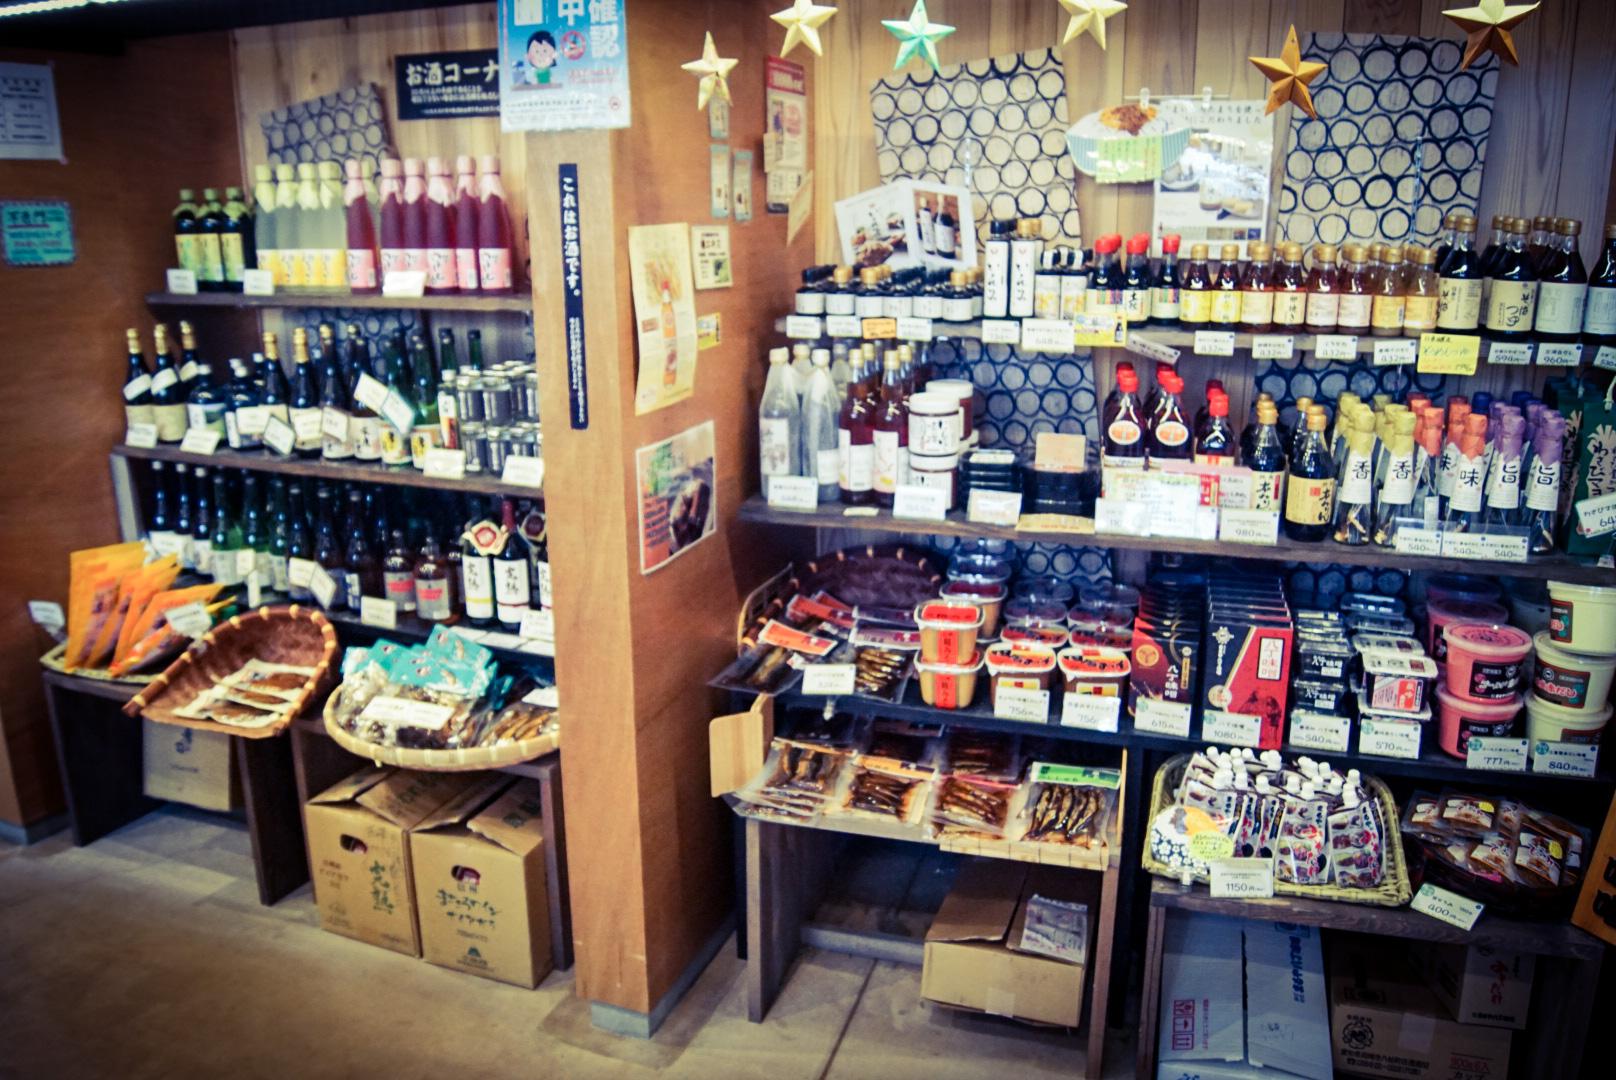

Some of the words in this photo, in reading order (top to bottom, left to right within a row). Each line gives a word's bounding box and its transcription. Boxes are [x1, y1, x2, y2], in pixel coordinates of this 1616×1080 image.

[563, 177, 580, 296] これはお酒です。
[1352, 460, 1370, 480] 香
[1392, 460, 1411, 480] 香
[1460, 468, 1479, 487] 味
[1502, 464, 1518, 483] 旨
[1537, 465, 1555, 485] 旨
[1165, 664, 1178, 699] 八丁味噌
